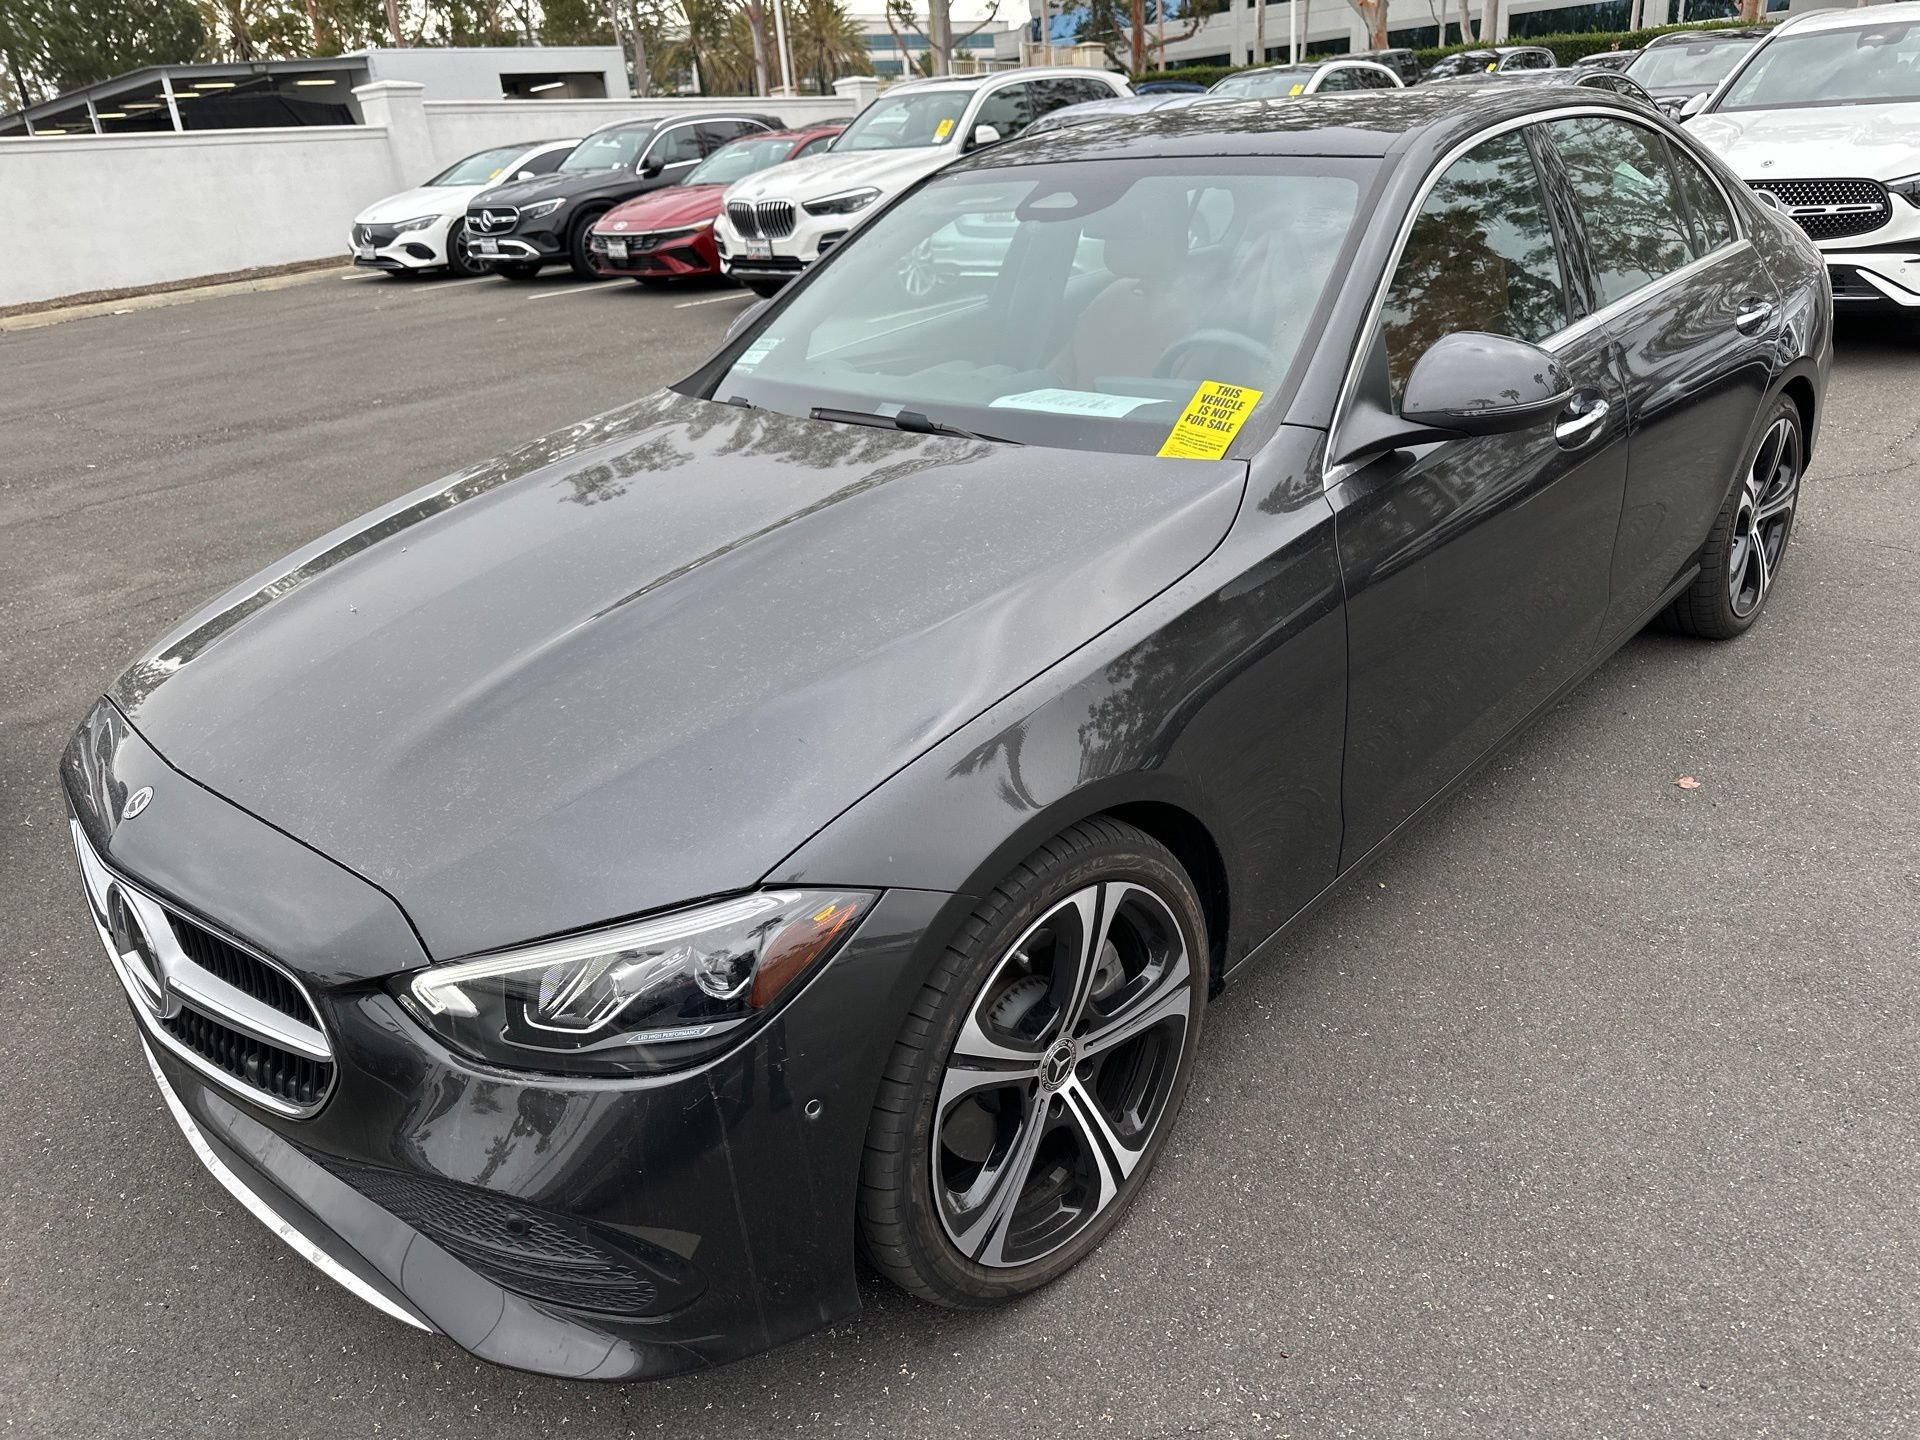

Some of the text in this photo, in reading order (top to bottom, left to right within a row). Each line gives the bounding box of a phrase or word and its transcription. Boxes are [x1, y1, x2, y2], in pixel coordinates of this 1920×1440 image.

[1216, 385, 1242, 398] THIS
[1201, 394, 1245, 411] VEHICLE
[1198, 405, 1234, 420] IS NOT
[1184, 413, 1206, 426] FOR
[1207, 418, 1234, 433] SALE
[648, 1032, 661, 1040] HIGH
[663, 1030, 700, 1038] PERFORMANCE
